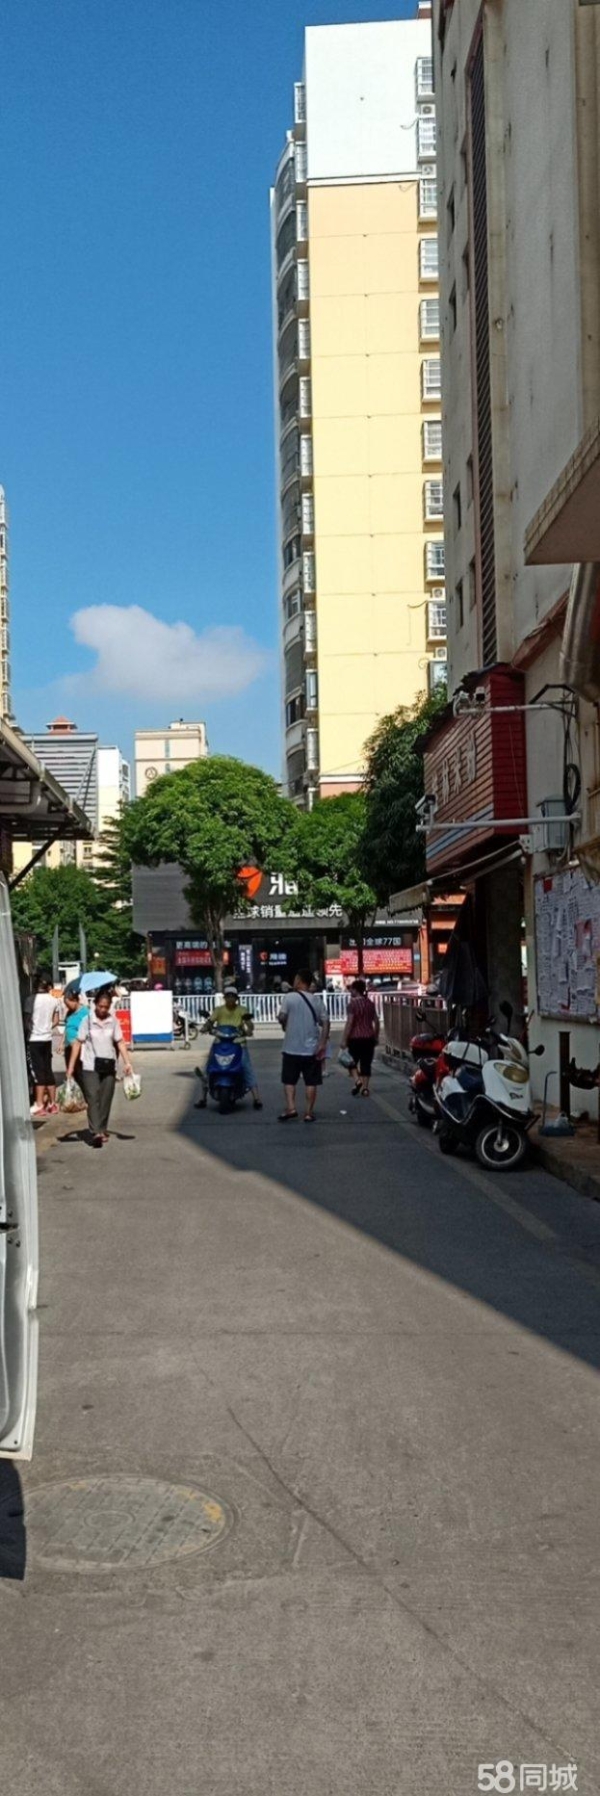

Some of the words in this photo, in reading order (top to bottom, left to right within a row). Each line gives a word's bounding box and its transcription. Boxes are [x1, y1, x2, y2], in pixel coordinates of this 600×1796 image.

[176, 941, 232, 950] 更高端的车
